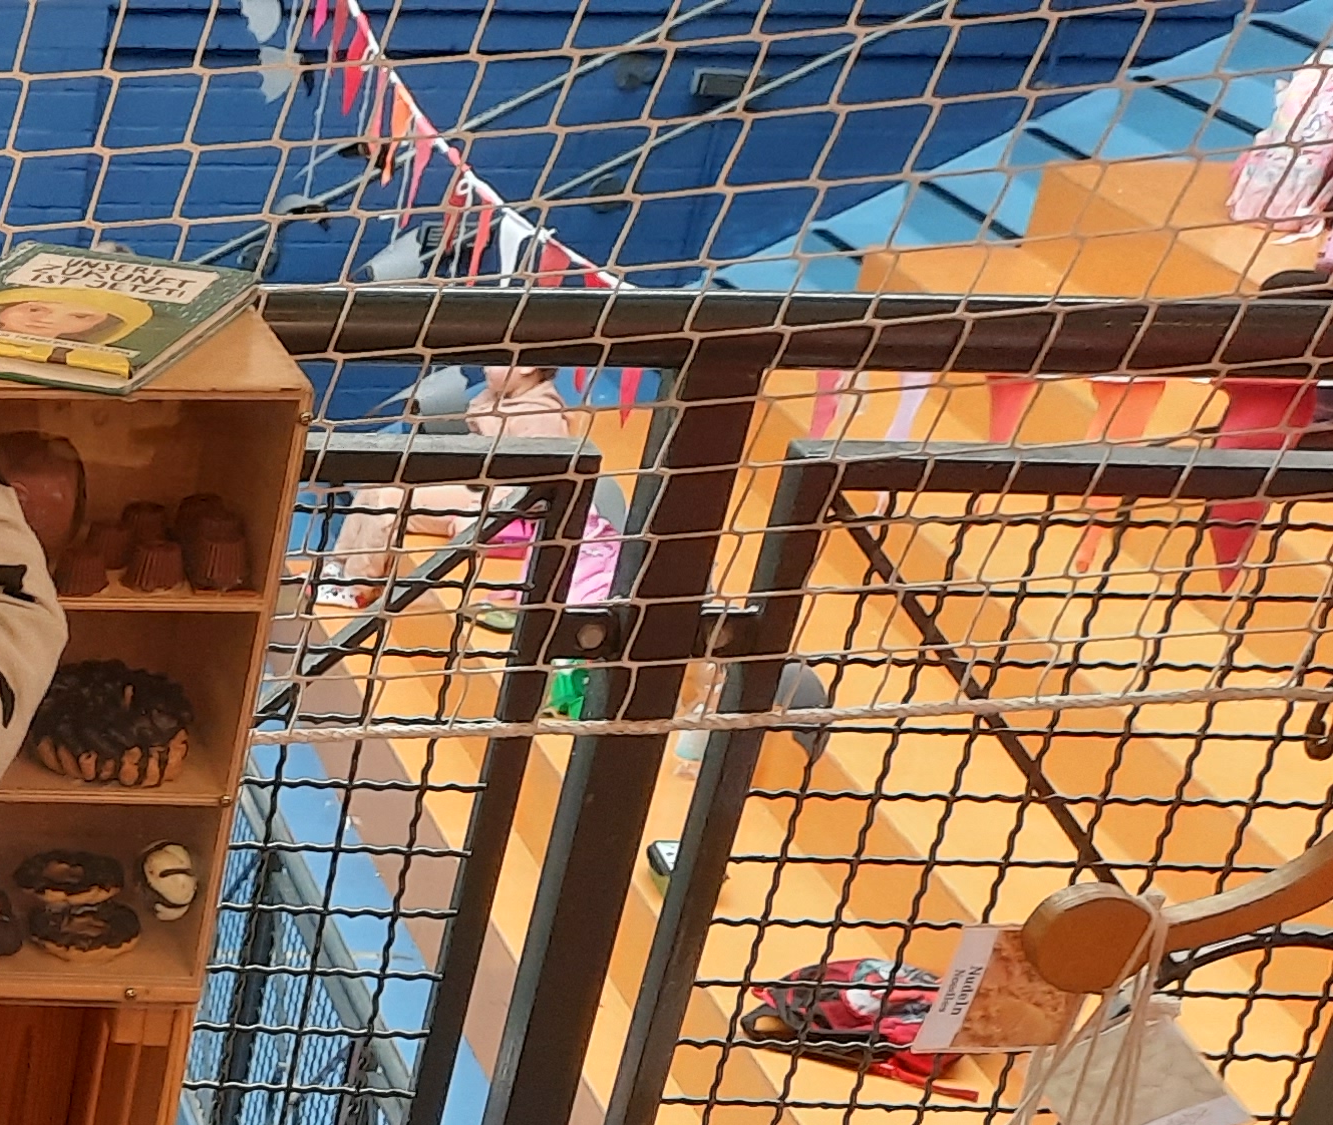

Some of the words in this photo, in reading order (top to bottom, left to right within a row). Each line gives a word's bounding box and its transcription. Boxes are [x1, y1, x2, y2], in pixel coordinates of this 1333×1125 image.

[31, 262, 197, 289] ZUKUNFT
[67, 257, 167, 276] UNSERE
[29, 273, 81, 286] IST
[85, 279, 187, 298] JETZT!
[950, 965, 985, 1016] Nudeln
